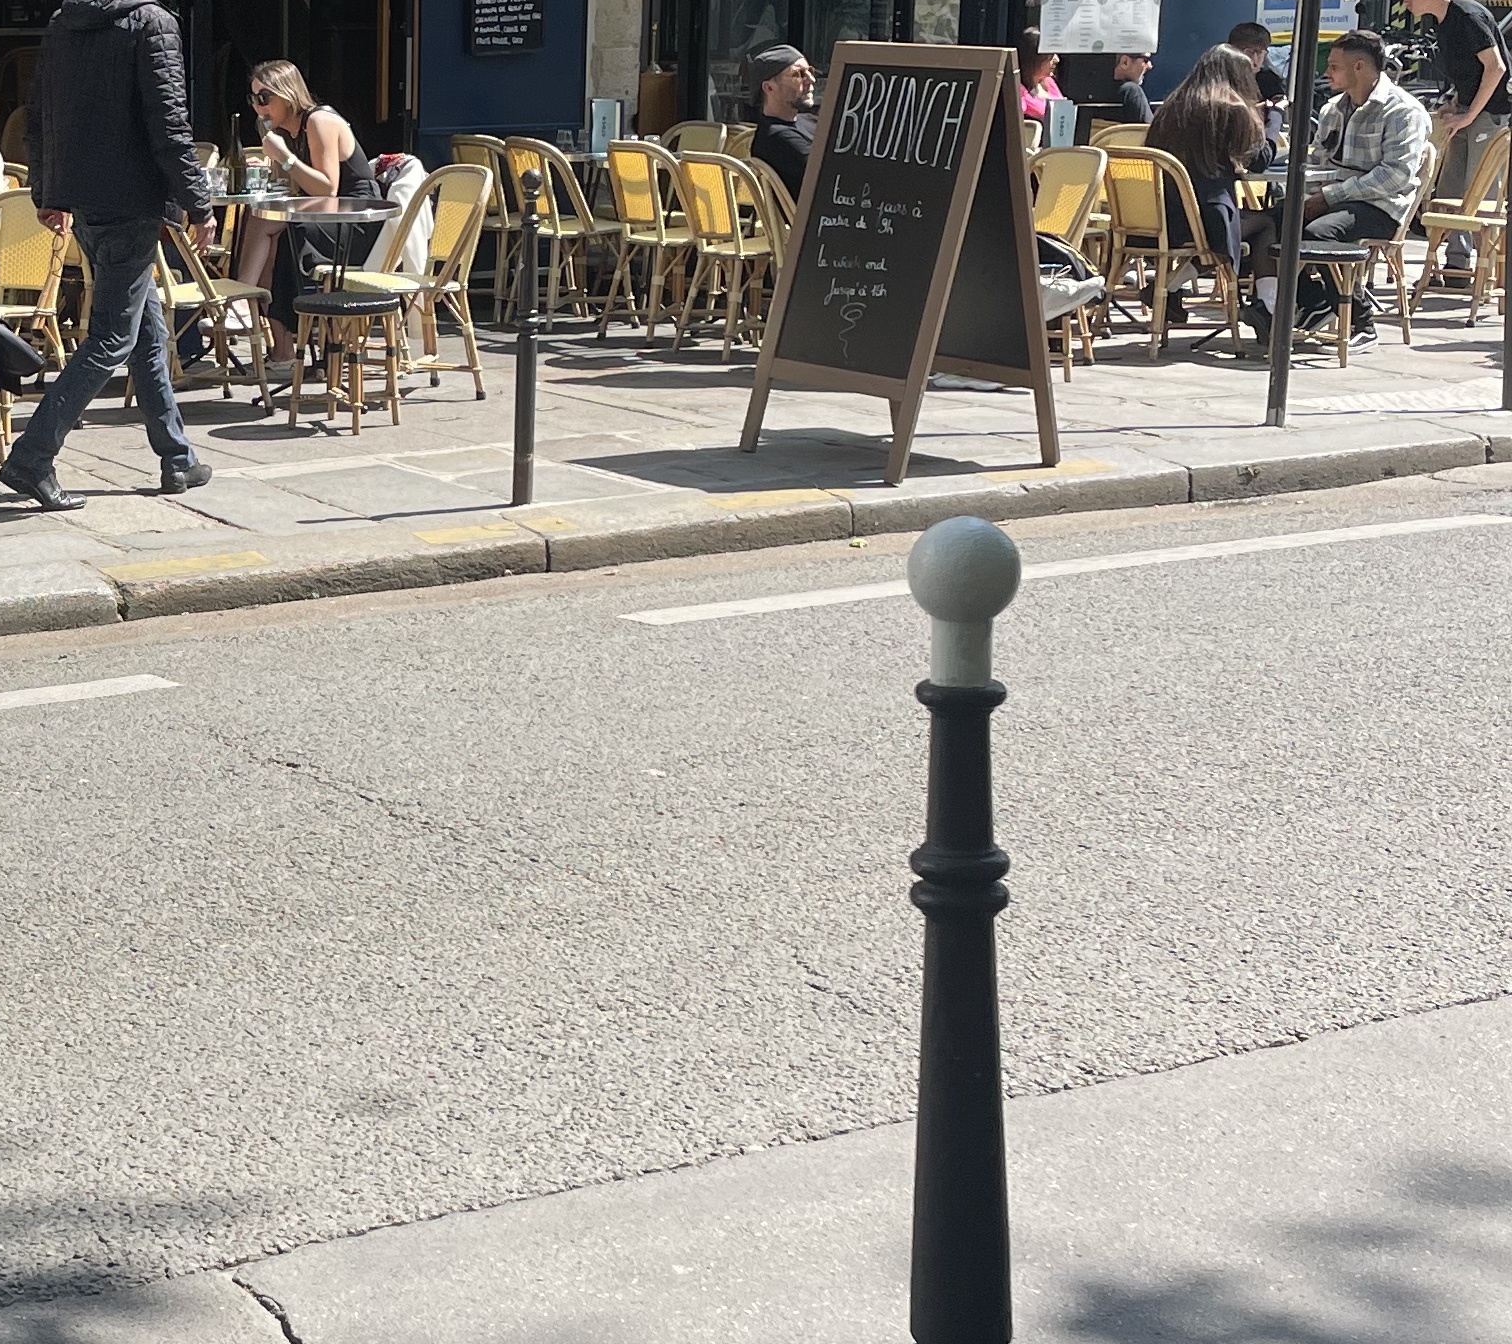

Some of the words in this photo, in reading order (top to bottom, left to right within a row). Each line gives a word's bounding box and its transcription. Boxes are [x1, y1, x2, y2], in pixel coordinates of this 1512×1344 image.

[834, 72, 974, 171] BRUNCH
[833, 174, 856, 206] tous
[876, 201, 908, 218] jours
[855, 215, 867, 229] de
[877, 217, 894, 235] 9h
